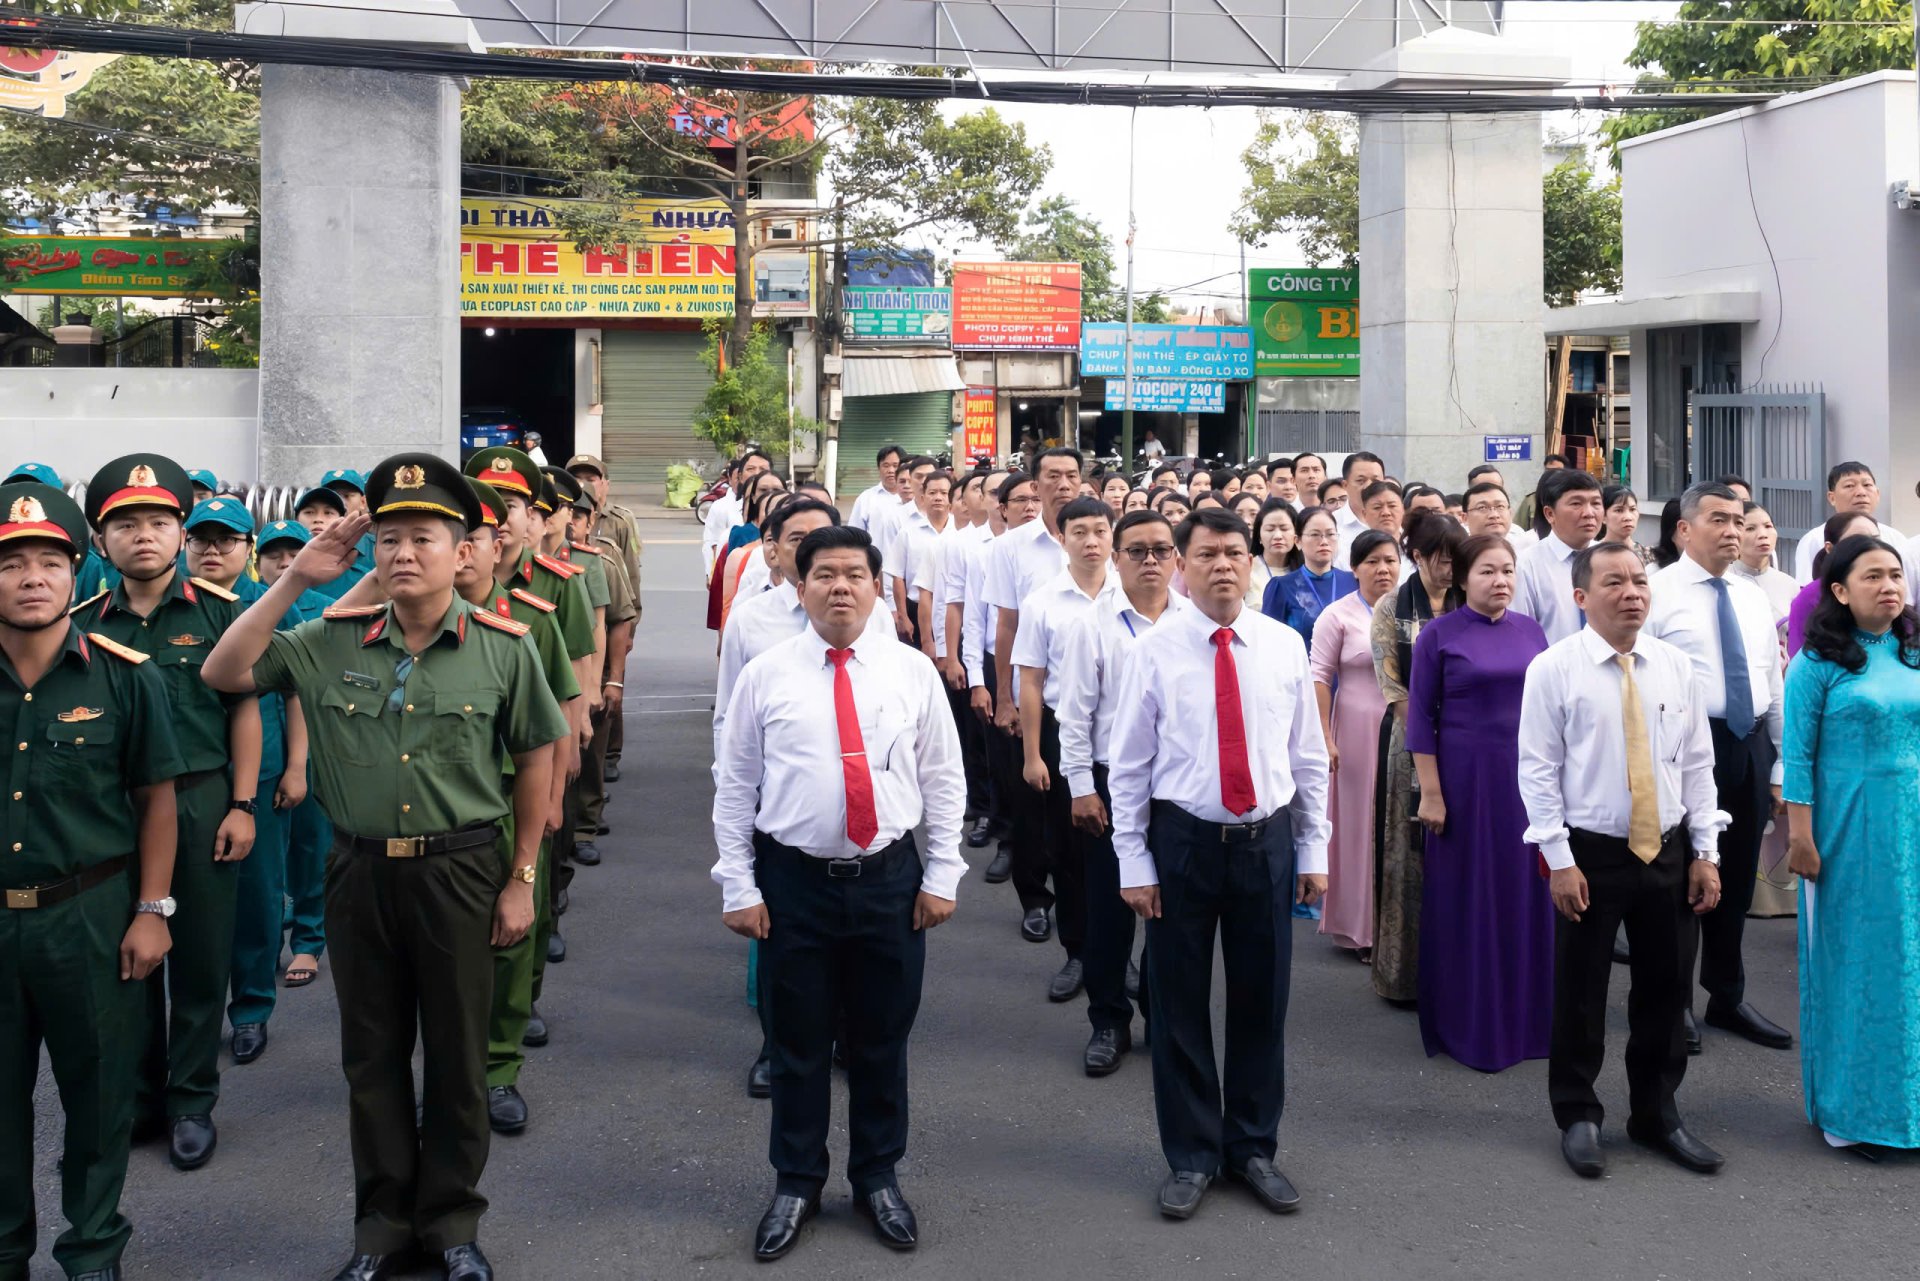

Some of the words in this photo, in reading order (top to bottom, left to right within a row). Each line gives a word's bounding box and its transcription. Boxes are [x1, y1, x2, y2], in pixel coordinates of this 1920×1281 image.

[1267, 273, 1322, 292] CÔNG
[1327, 277, 1352, 292] TY
[722, 284, 735, 295] TH
[481, 300, 537, 312] ECOPLAST
[540, 300, 562, 312] CAO
[632, 301, 661, 313] ZUKO
[687, 301, 734, 313] ZUKOSTA
[963, 324, 999, 332] PHOTO
[1001, 324, 1034, 333] COPPY
[1106, 379, 1187, 397] PHTOCOPY
[1190, 383, 1211, 397] 240
[967, 400, 994, 413] PHOTO
[966, 416, 994, 429] COPPY
